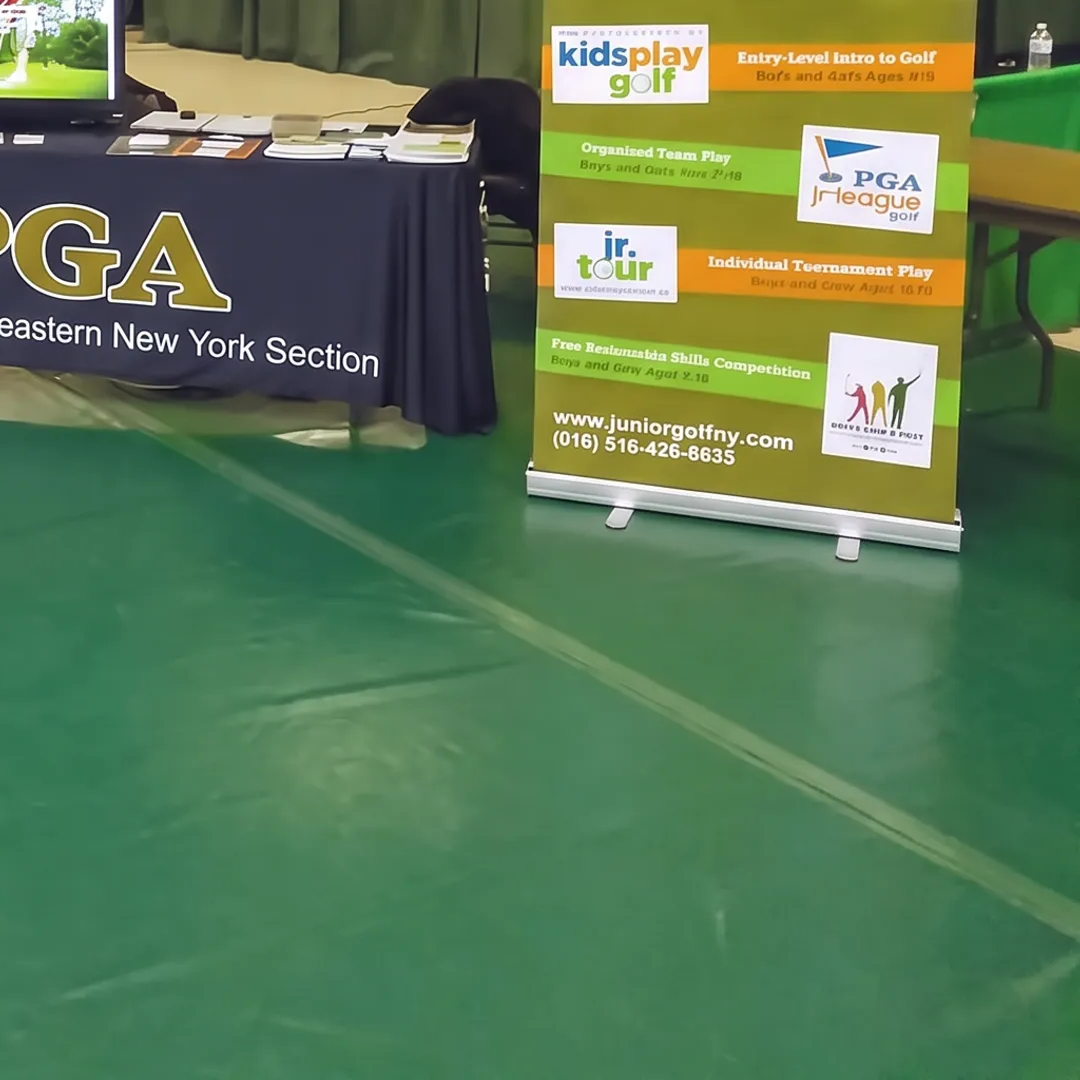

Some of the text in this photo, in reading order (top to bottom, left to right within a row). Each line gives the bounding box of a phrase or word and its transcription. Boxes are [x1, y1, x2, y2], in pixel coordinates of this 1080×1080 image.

[558, 40, 704, 72] kidsplay
[736, 50, 937, 68] Entry-Level Intro to Golf
[609, 67, 676, 98] golf
[795, 70, 823, 82] and
[866, 71, 904, 84] Ages
[656, 147, 698, 162] Team
[701, 151, 732, 166] Play
[615, 162, 640, 175] and
[853, 170, 922, 191] PGA
[889, 212, 920, 222] golf
[576, 254, 654, 282] tour
[708, 256, 789, 271] Individual
[897, 264, 934, 281] Play
[789, 279, 817, 290] and
[112, 321, 180, 355] New
[188, 328, 256, 362] York
[264, 337, 380, 378] Section
[551, 337, 582, 352] Free
[584, 360, 610, 372] and
